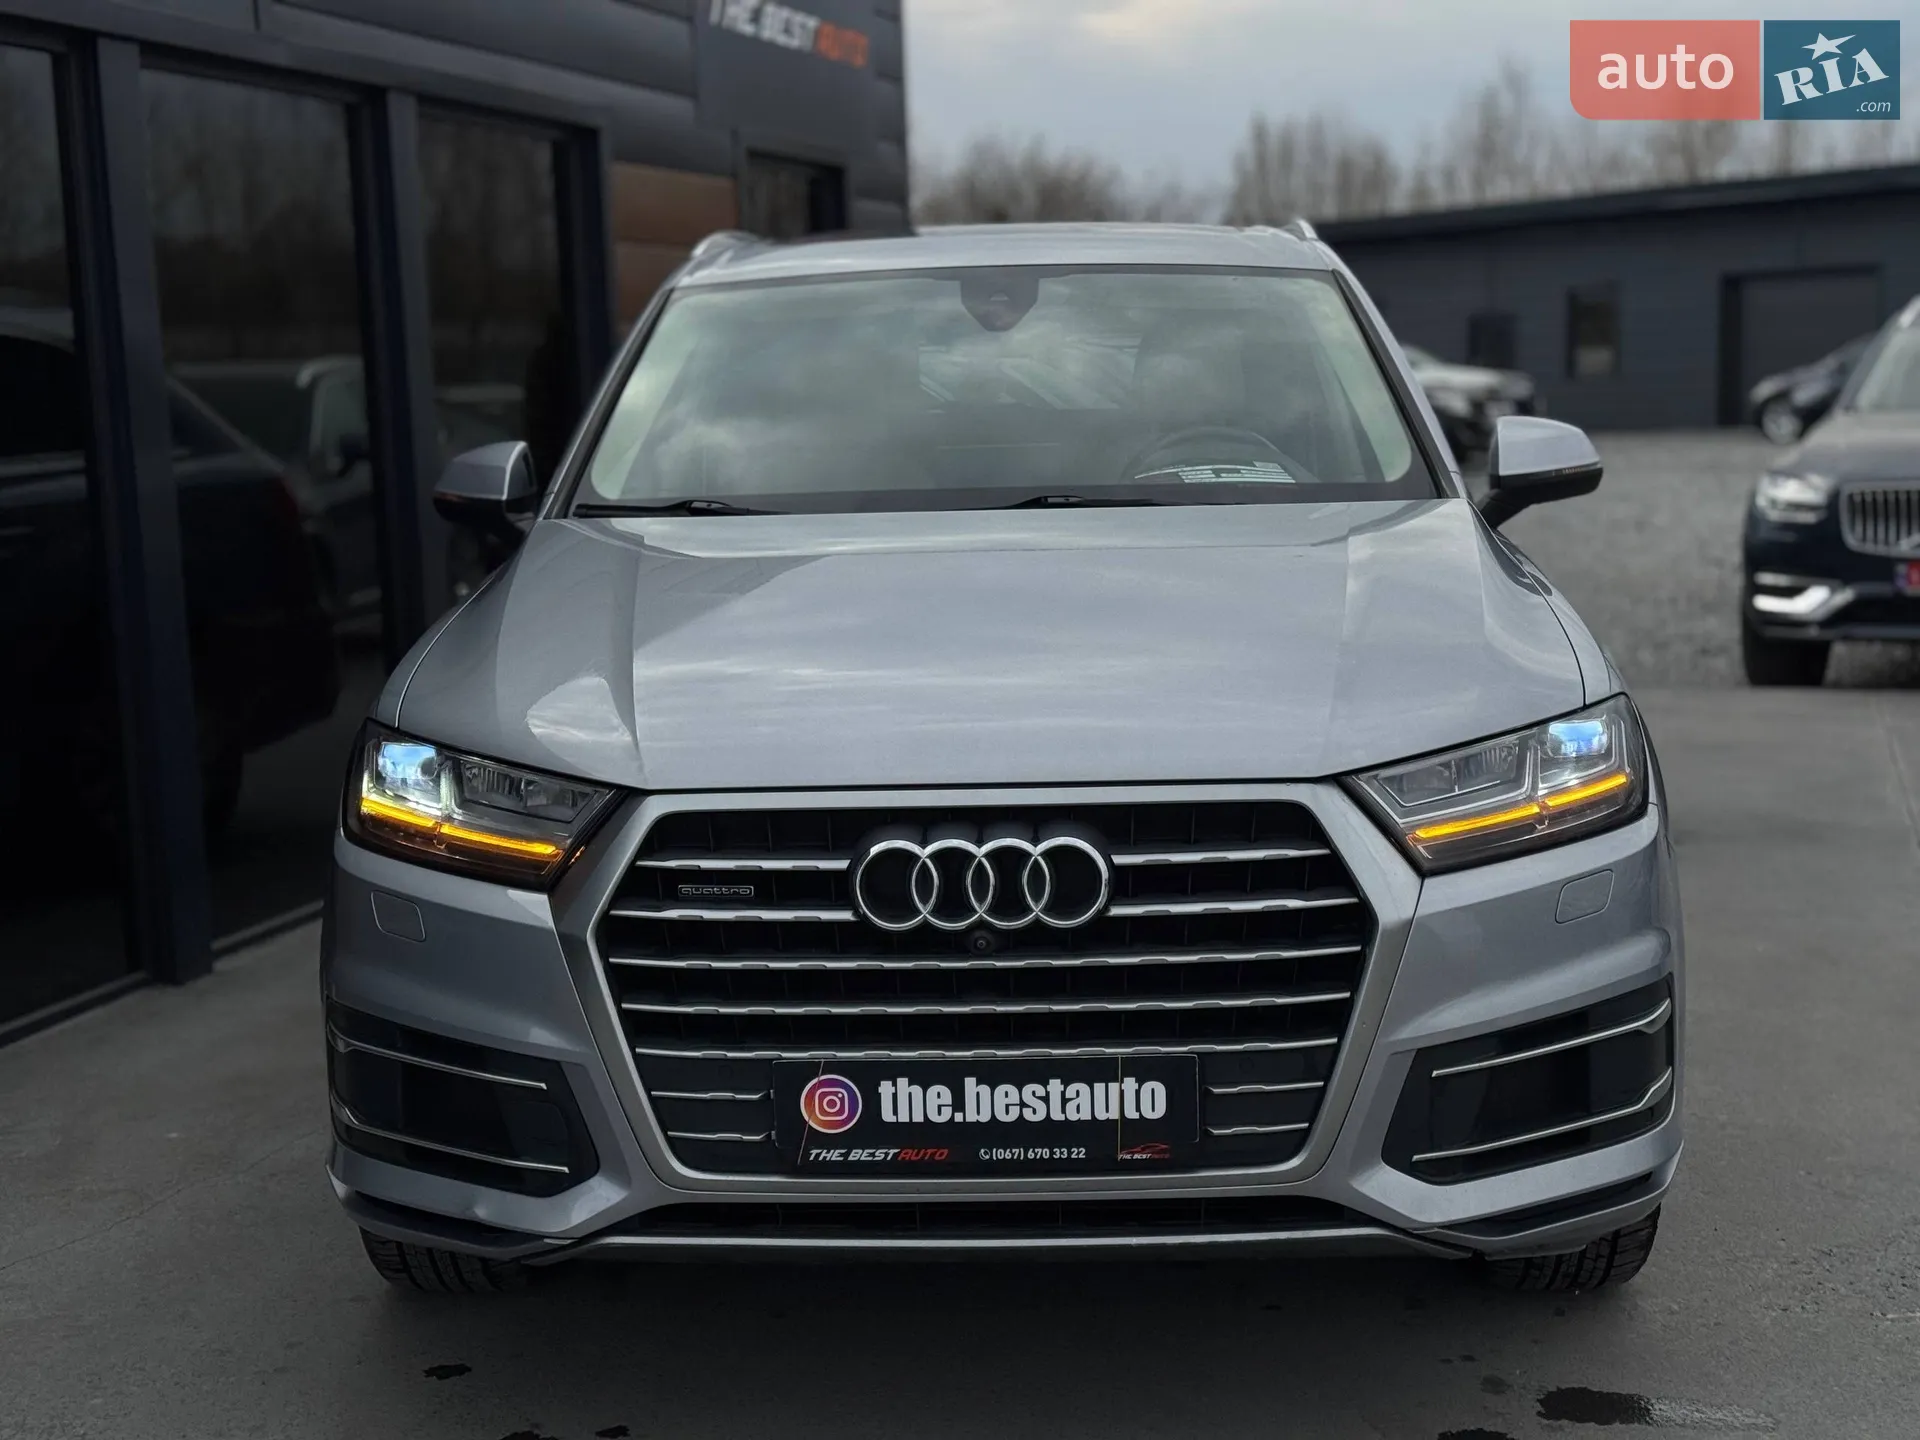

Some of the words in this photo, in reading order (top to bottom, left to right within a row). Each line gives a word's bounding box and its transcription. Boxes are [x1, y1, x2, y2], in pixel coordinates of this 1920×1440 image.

[681, 887, 750, 896] quattro
[878, 1077, 1167, 1124] the.bestauto
[808, 1148, 848, 1161] THE
[992, 1148, 1025, 1161] (067)
[1027, 1148, 1050, 1160] 670
[1053, 1148, 1069, 1160] 33
[1070, 1147, 1087, 1160] 22
